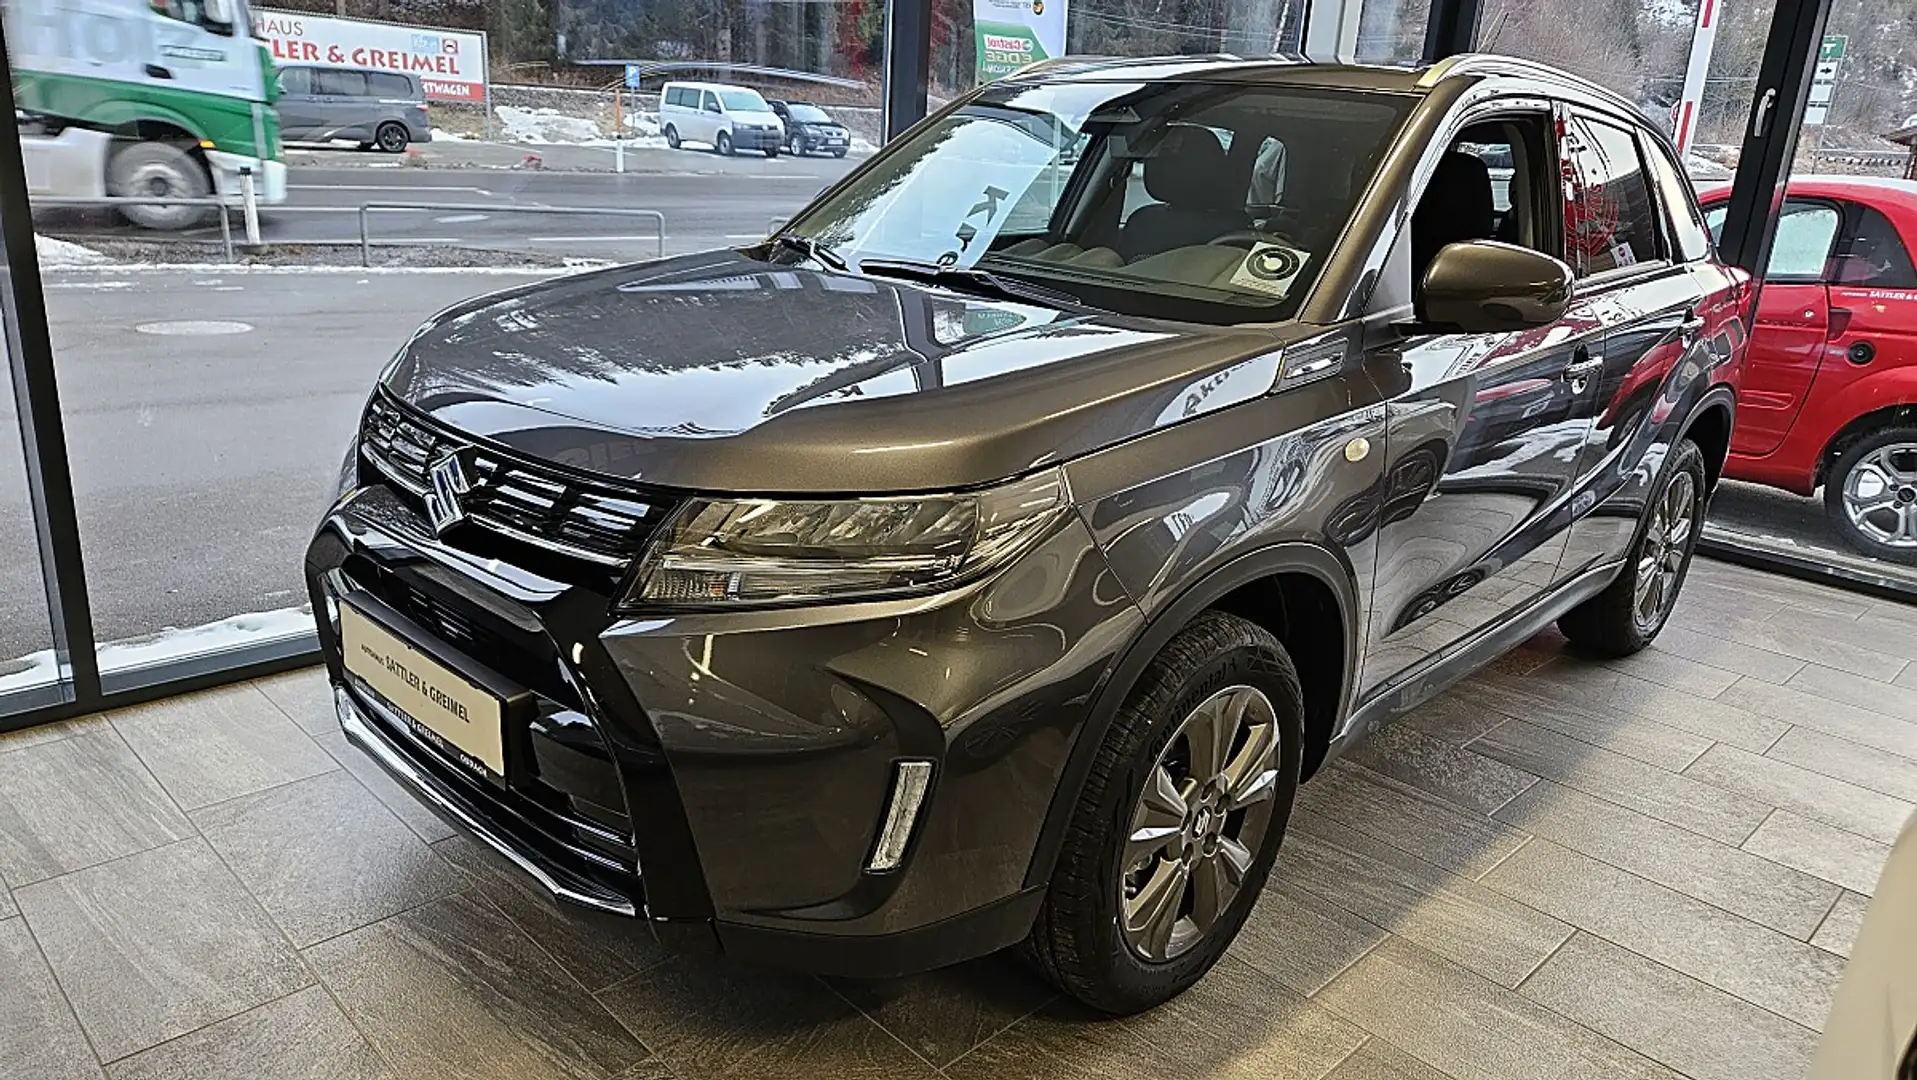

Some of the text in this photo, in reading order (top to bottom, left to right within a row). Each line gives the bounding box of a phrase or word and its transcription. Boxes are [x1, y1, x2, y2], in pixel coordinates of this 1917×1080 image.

[327, 44, 345, 64] &
[351, 47, 460, 75] GREIMEL
[385, 655, 420, 692] SATTLER
[420, 680, 428, 697] &
[428, 685, 471, 724] GREIMEL
